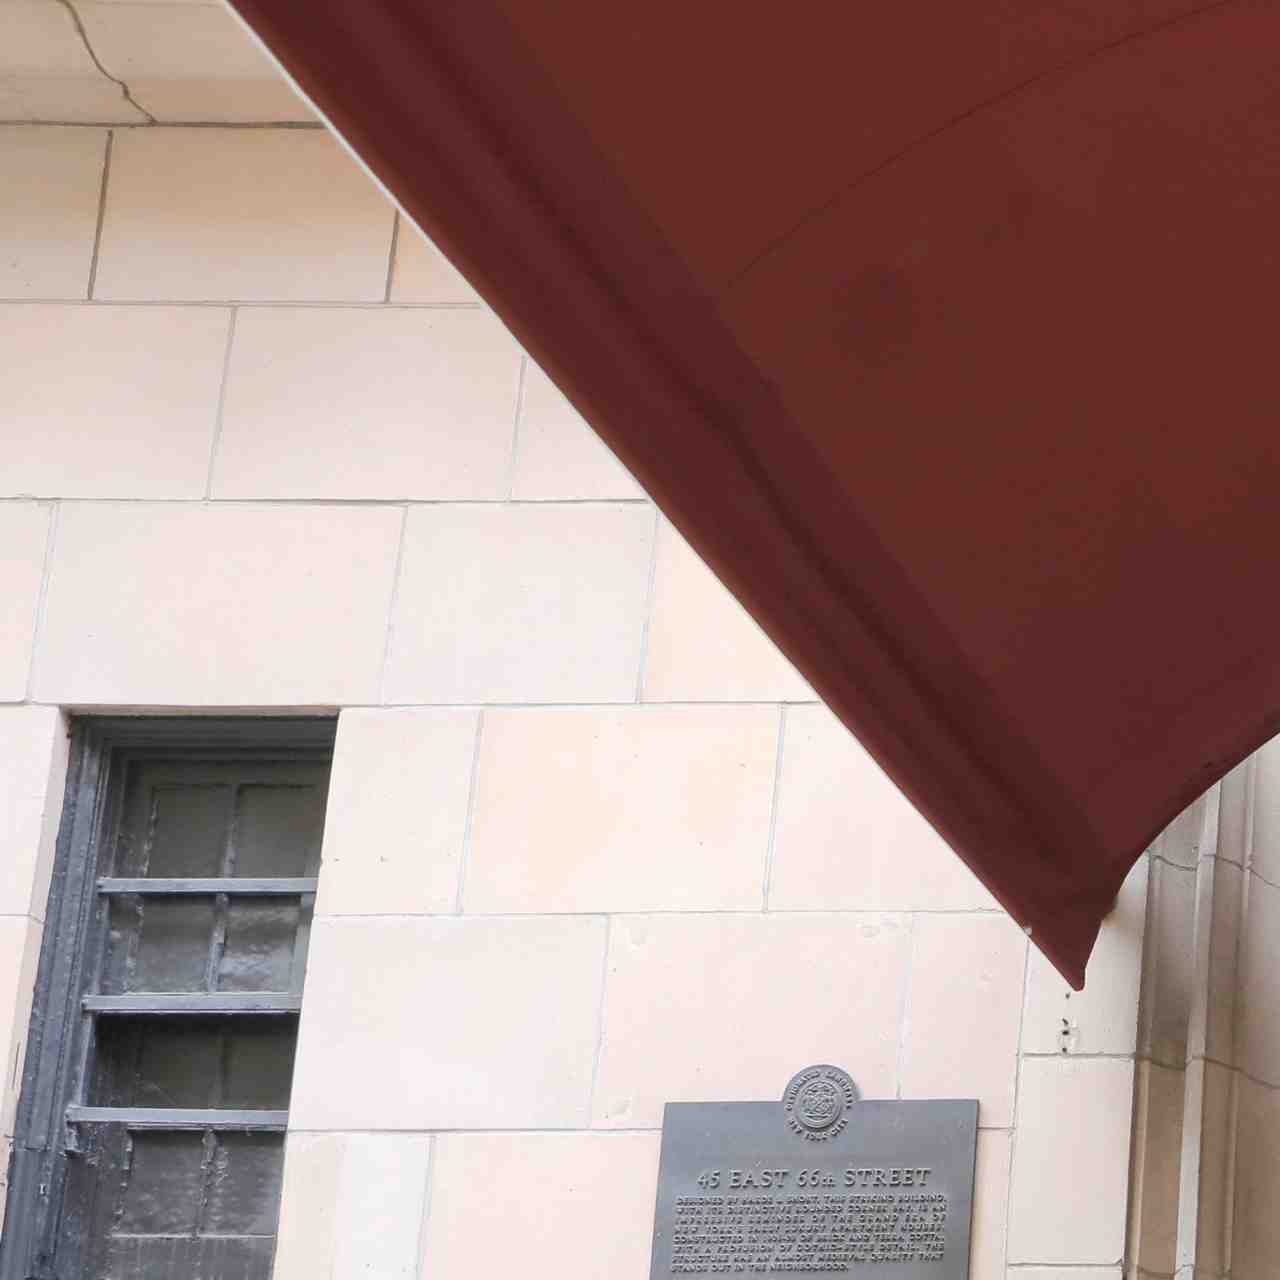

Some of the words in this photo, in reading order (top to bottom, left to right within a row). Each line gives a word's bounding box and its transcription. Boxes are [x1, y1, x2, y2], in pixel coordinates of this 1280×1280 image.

[697, 1171, 721, 1188] 45
[728, 1169, 789, 1188] EAST
[844, 1167, 932, 1187] STREET
